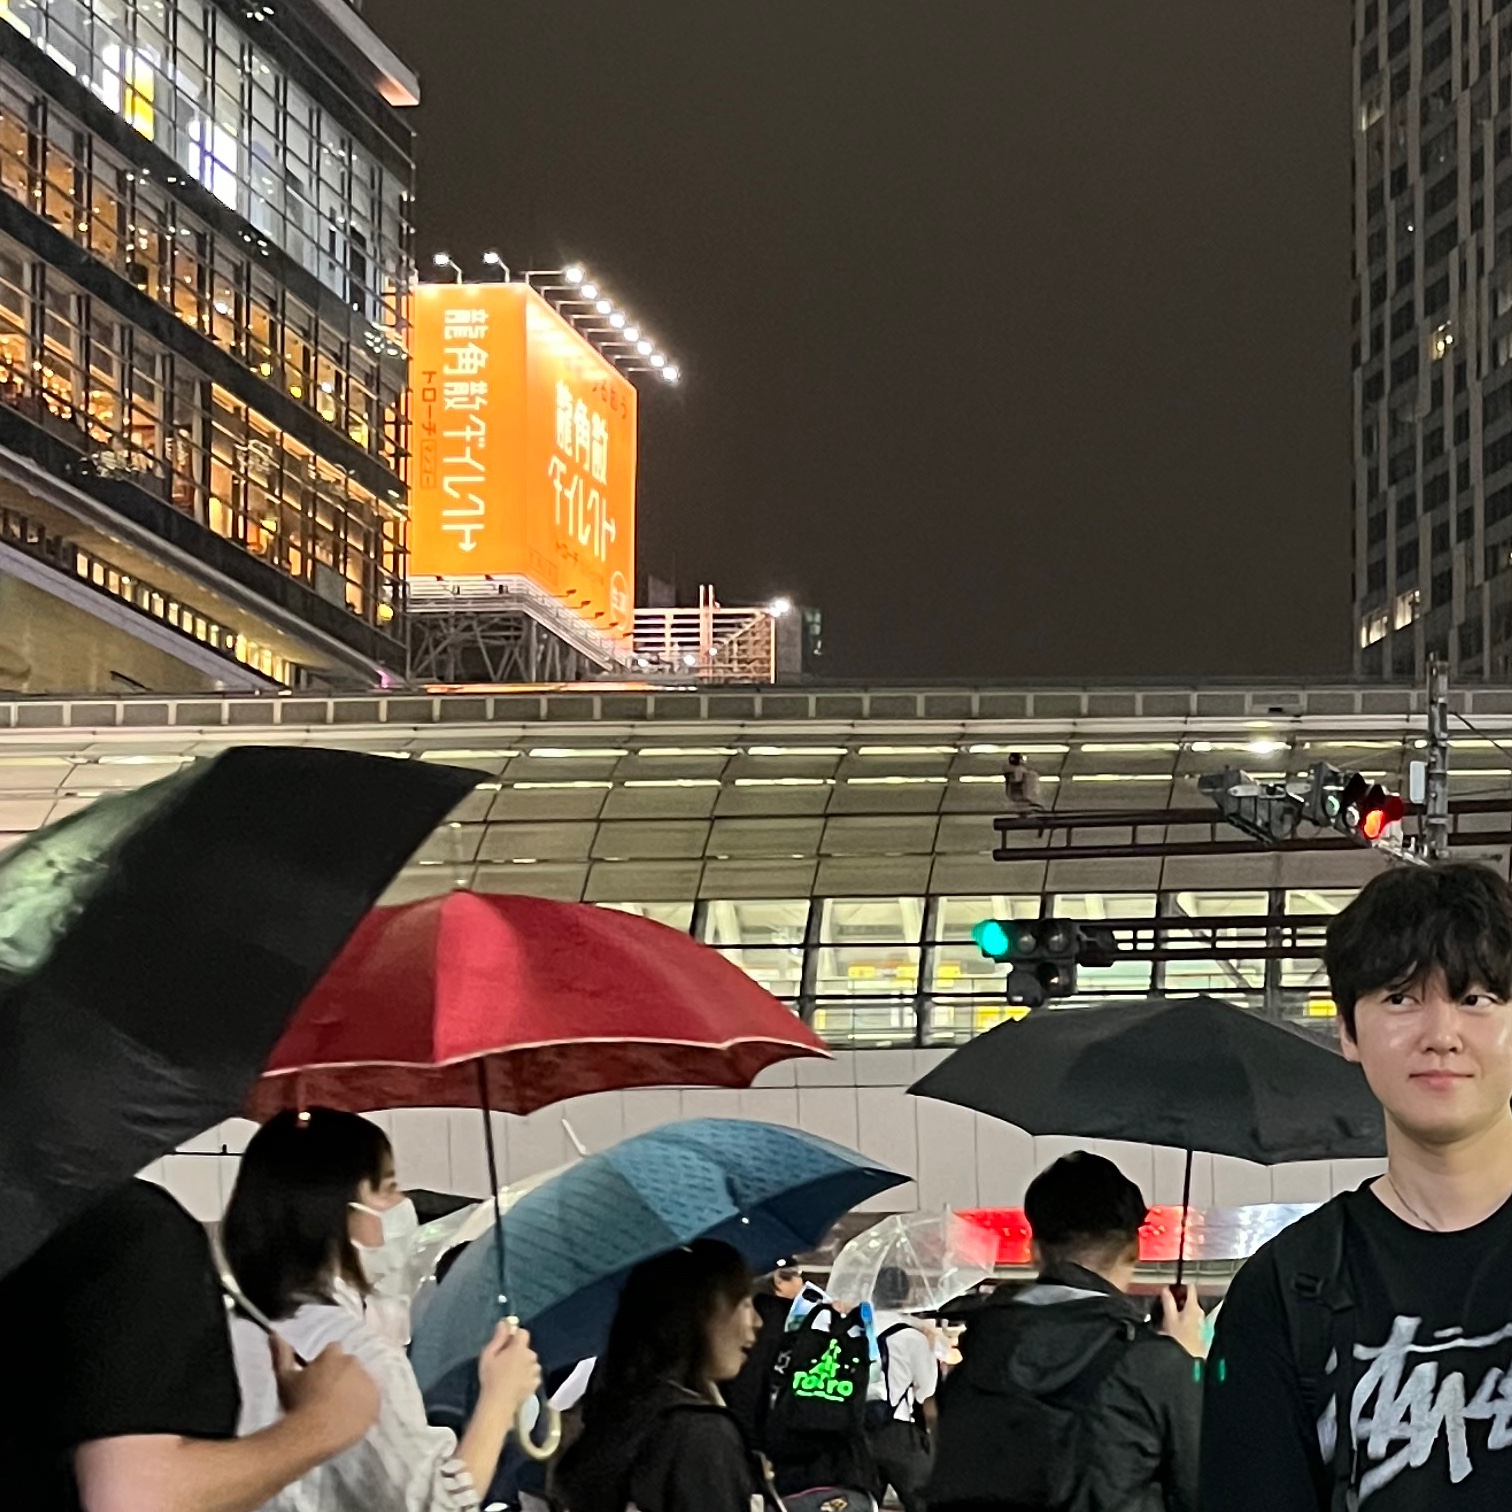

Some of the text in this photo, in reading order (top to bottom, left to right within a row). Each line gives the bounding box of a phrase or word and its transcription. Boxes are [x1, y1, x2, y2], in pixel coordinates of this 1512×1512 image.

[441, 308, 489, 552] 龍角散ダイレクト
[555, 379, 609, 486] 龍角散
